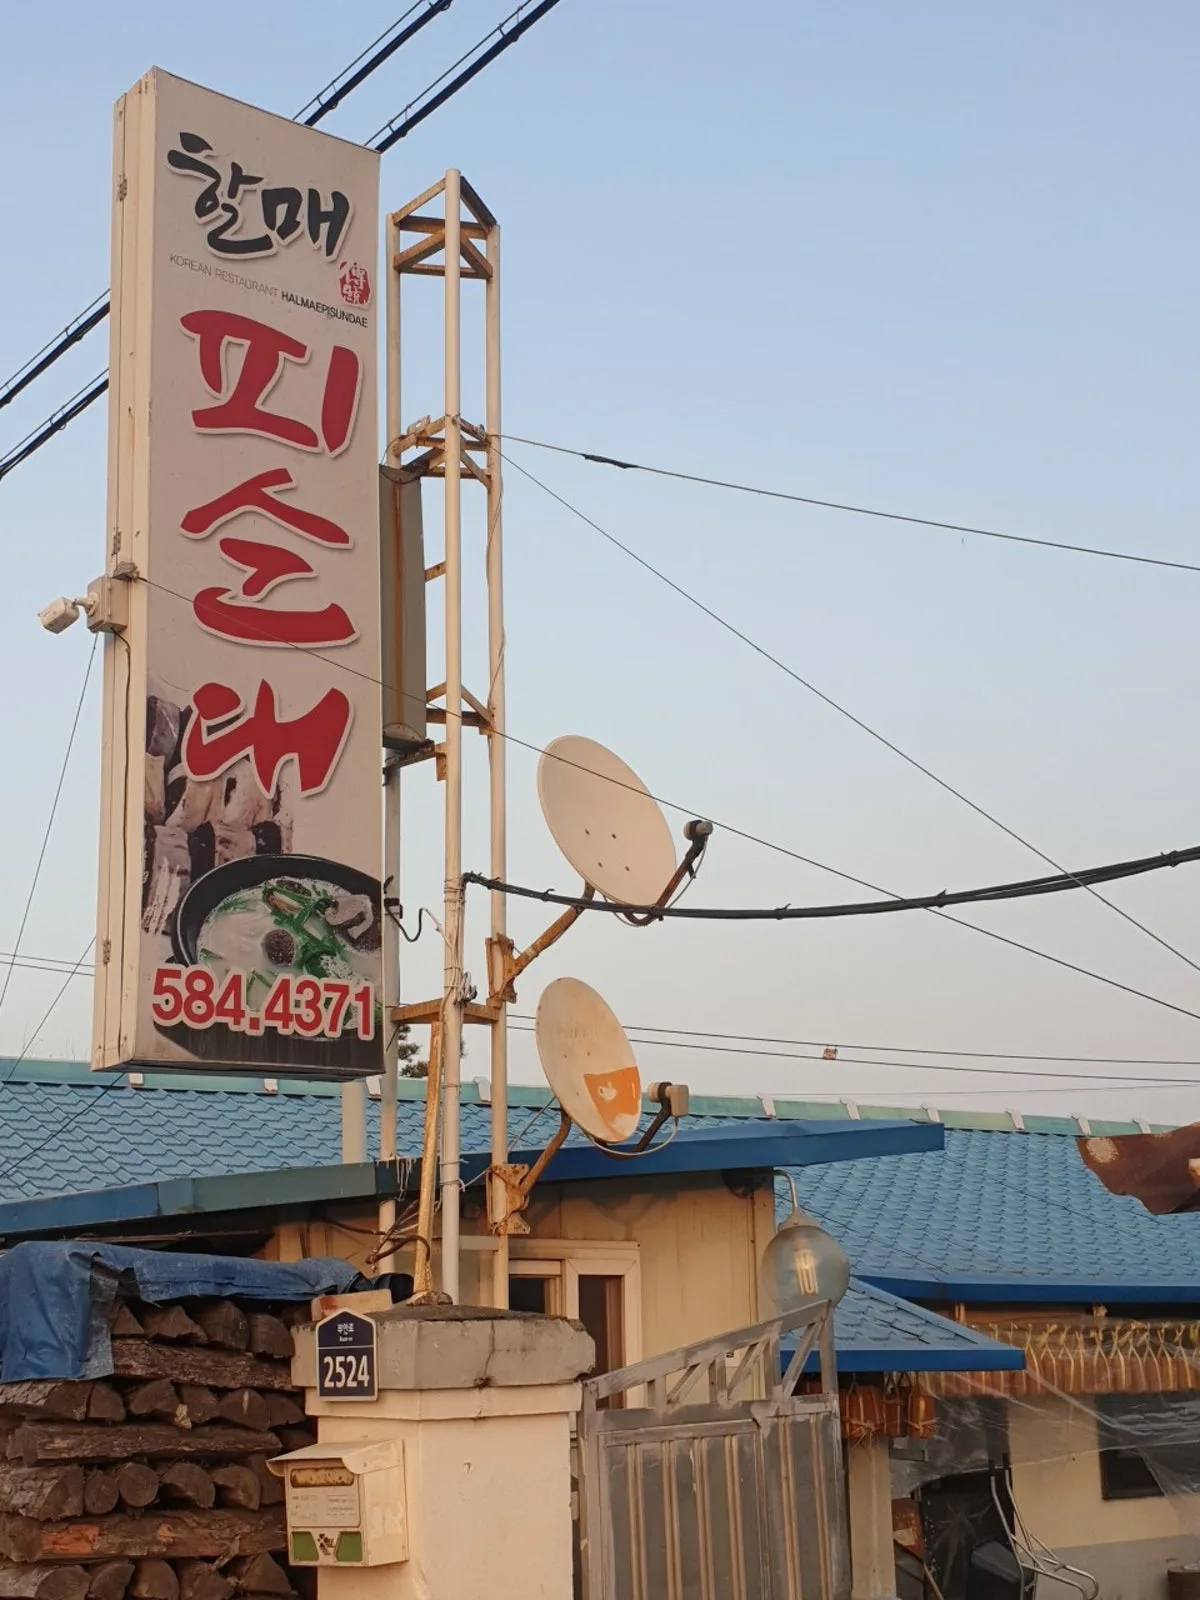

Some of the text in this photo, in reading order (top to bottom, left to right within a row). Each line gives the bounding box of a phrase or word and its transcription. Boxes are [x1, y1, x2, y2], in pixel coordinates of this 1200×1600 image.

[167, 132, 350, 257] 할매
[169, 253, 368, 328] KOREAN RESTAURANT HALMAEPISUNDAE
[180, 309, 359, 794] 피순대
[152, 968, 371, 1036] 584.4371
[323, 1354, 370, 1388] 2524
